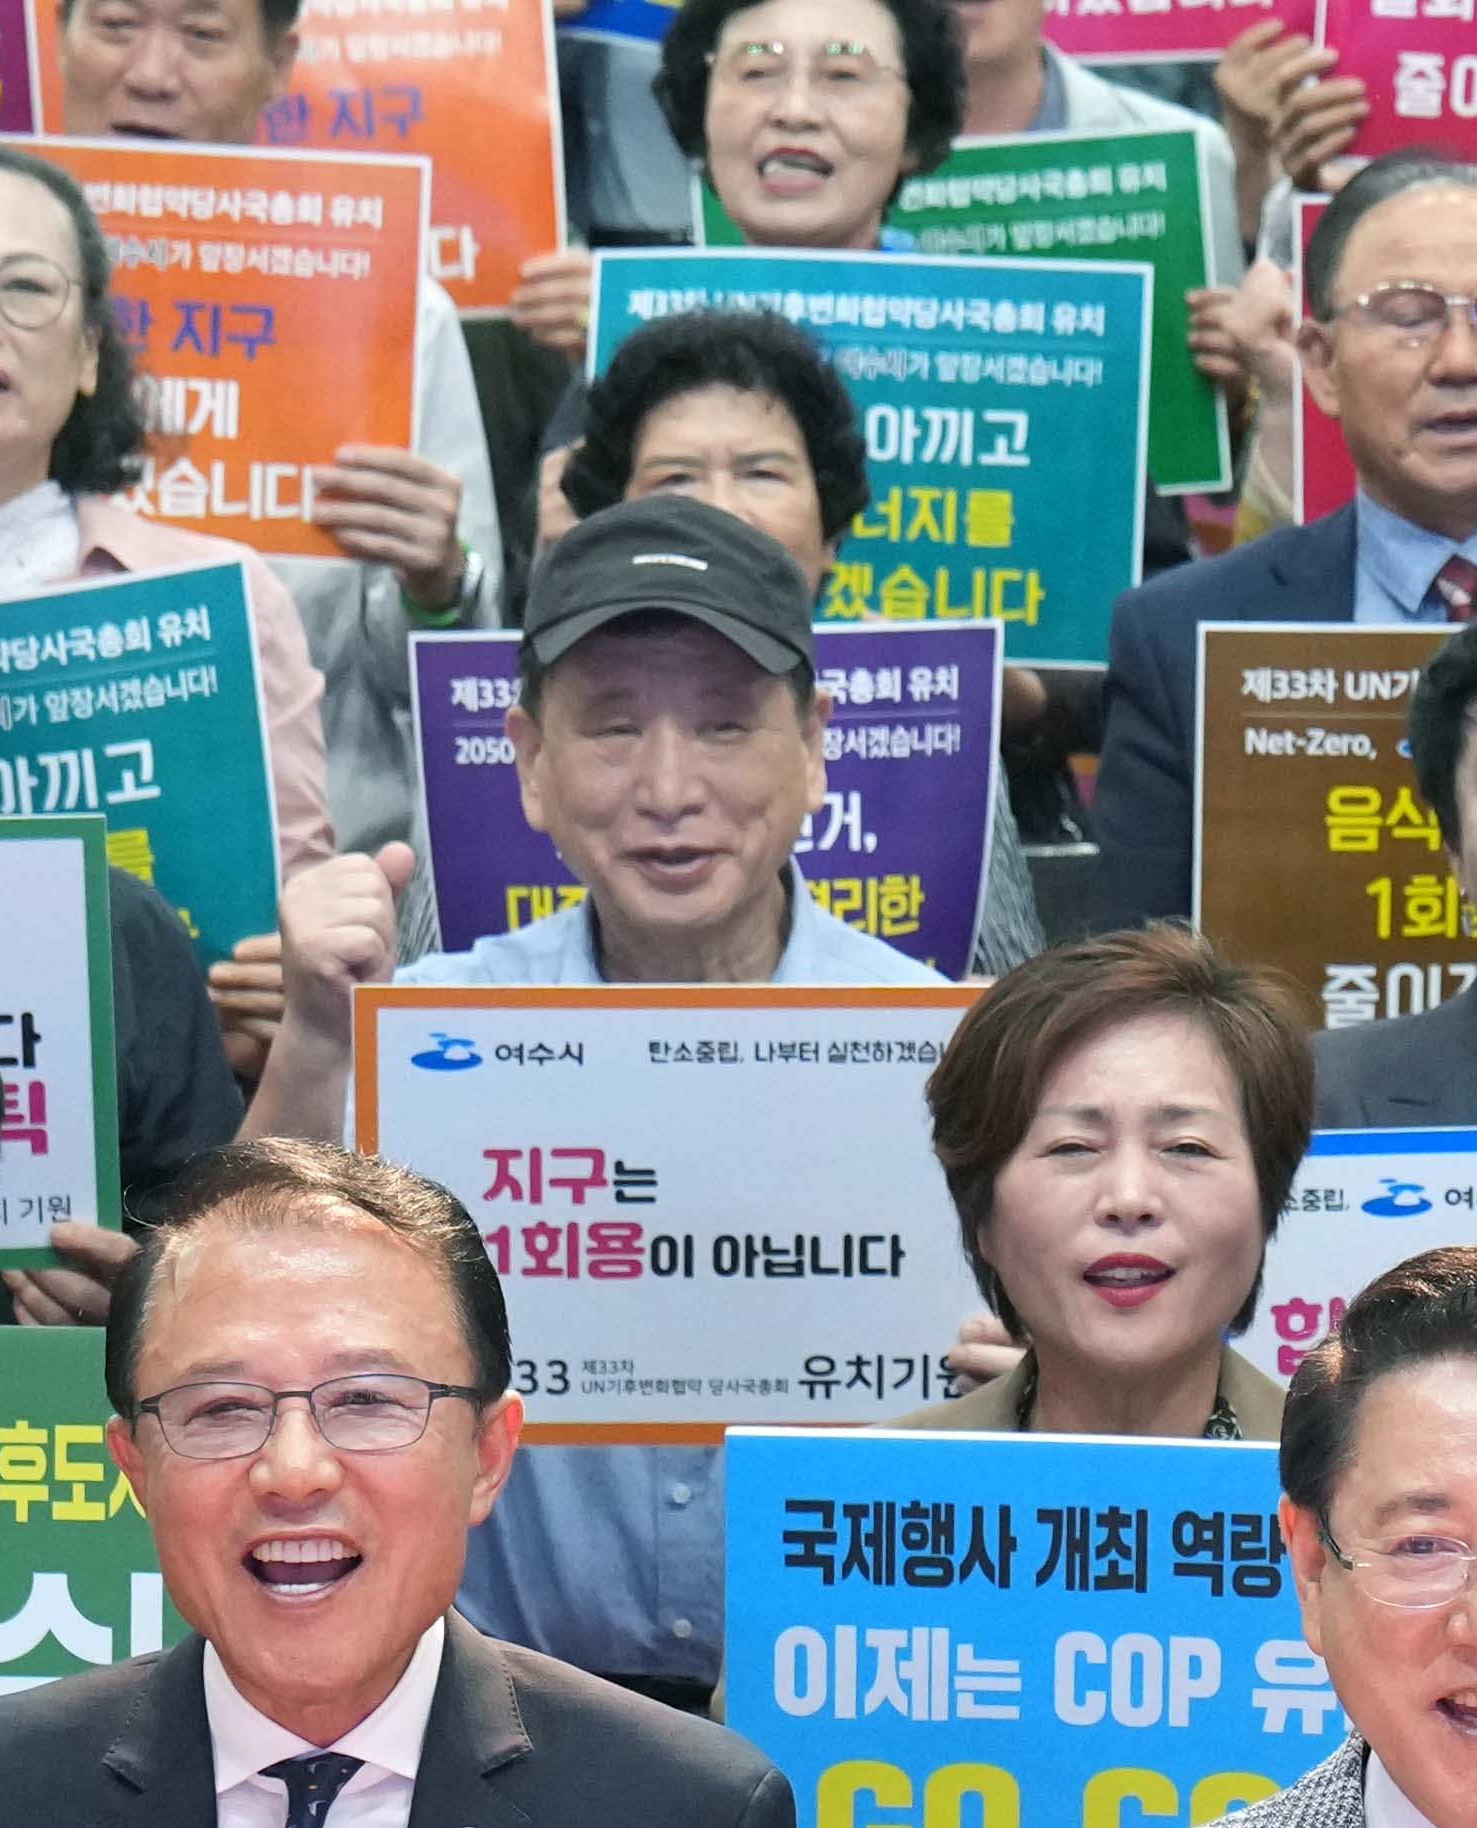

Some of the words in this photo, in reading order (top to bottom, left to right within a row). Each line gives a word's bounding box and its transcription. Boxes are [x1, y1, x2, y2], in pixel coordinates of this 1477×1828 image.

[171, 303, 277, 361] 지구
[866, 407, 1030, 468] 아끼고
[157, 606, 211, 644] 유치
[43, 666, 218, 722] 앞장서겠습니다!
[908, 663, 959, 702] 유치
[1242, 668, 1338, 704] 제33차
[1244, 727, 1377, 761] Net-Zero,
[494, 1041, 585, 1067] 여수시
[753, 1040, 821, 1065] 나부터
[482, 1147, 659, 1205] 지구는
[19, 1195, 74, 1224] 기원
[712, 1234, 906, 1280] 아닙니다
[582, 1359, 635, 1374] 제33차
[581, 1377, 702, 1396] UN기후변화협약
[782, 1497, 1017, 1590] 국제행사
[1035, 1504, 1149, 1593] 개최
[1171, 1507, 1287, 1599] 역량
[773, 1624, 1021, 1723] 이제는
[1054, 1630, 1222, 1727] COP
